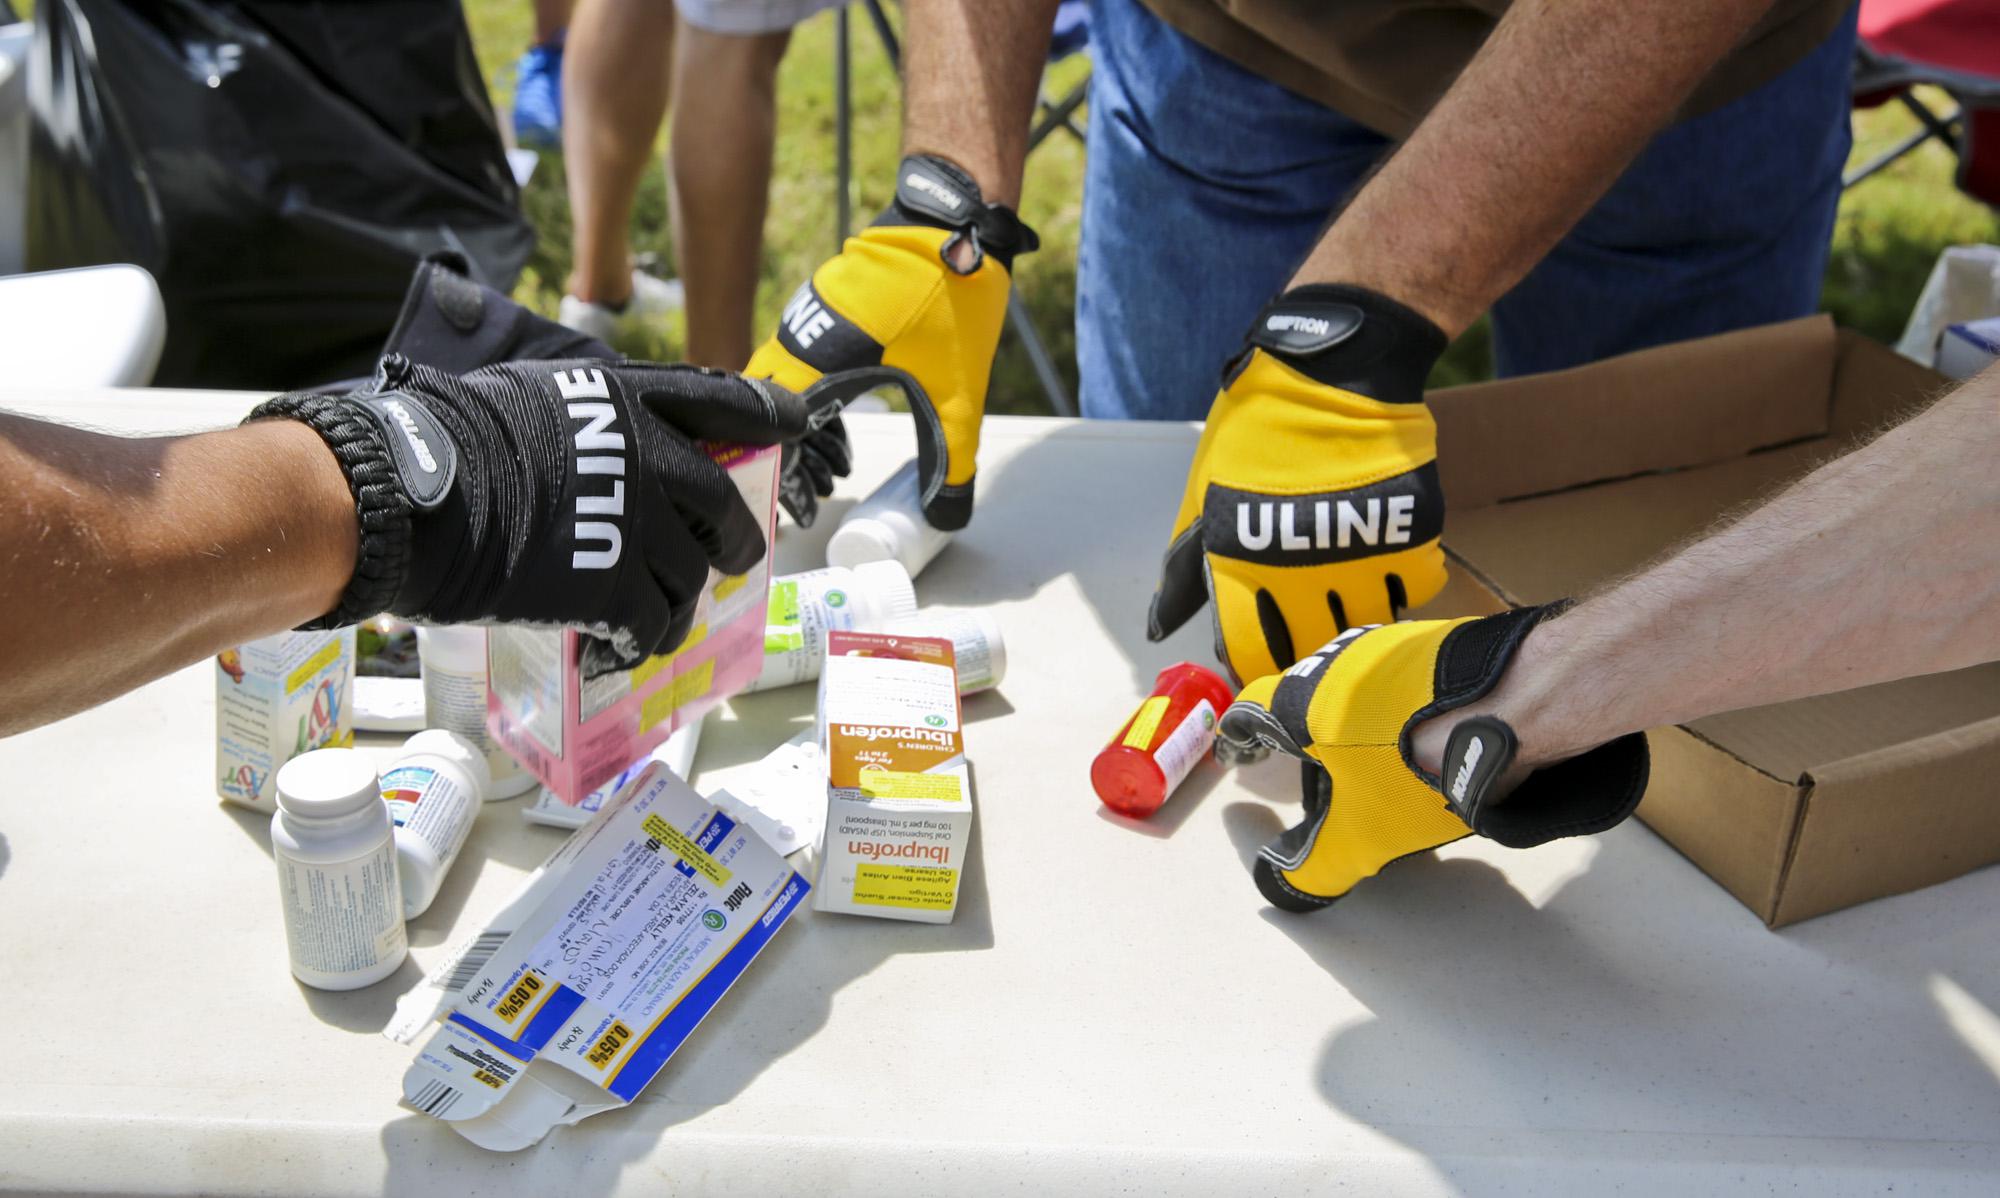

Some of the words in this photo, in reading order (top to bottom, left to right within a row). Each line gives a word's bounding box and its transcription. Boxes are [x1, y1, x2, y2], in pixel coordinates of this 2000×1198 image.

[553, 367, 626, 569] ULINE
[1237, 495, 1415, 551] ULINE
[839, 724, 953, 746] Ibuprofen
[896, 741, 954, 752] CHILDREN'S
[845, 815, 887, 825] (teaspoon)
[909, 820, 922, 828] per
[922, 820, 936, 829] mg
[838, 825, 869, 834] (NSAID)
[937, 822, 952, 830] 100
[870, 828, 886, 836] USP
[887, 829, 934, 839] Suspension,
[935, 832, 951, 840] Oral
[847, 841, 949, 864] Ibuprofen
[721, 880, 754, 914] Flutic
[497, 975, 540, 1020] 0.05%
[588, 1024, 630, 1067] 0.05%
